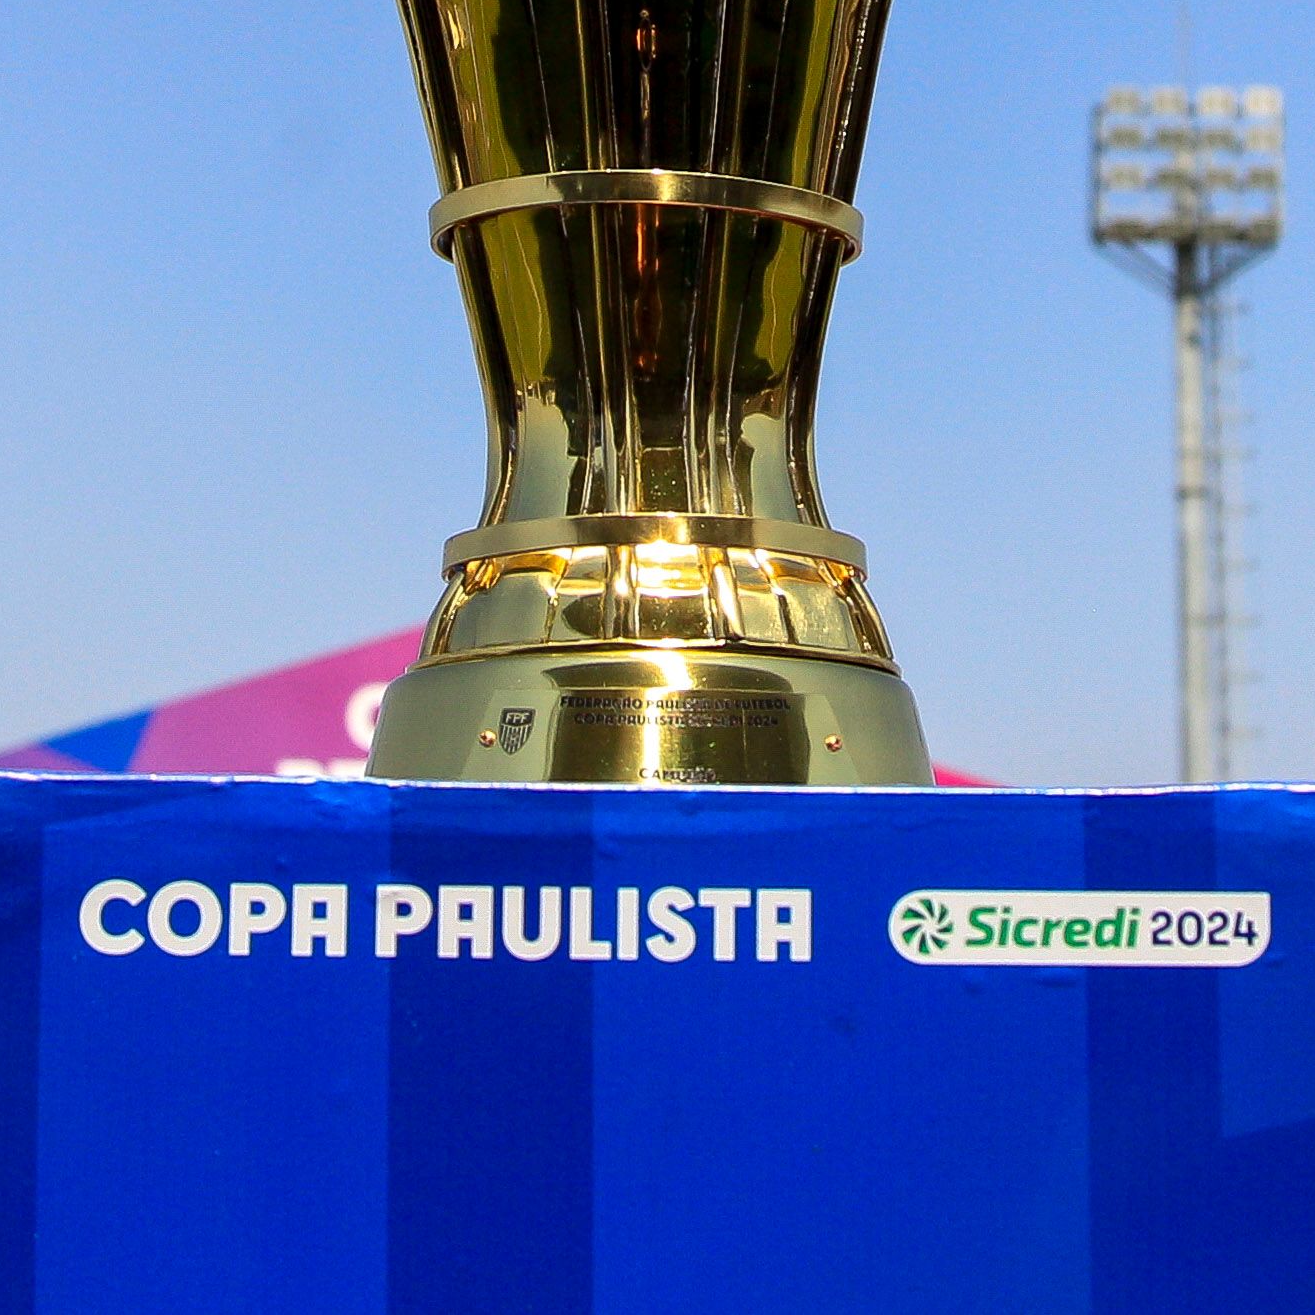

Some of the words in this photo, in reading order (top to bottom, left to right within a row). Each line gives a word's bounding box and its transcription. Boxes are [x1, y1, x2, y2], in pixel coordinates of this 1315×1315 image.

[506, 712, 531, 724] FPF
[79, 879, 347, 957] COPA
[375, 883, 812, 962] PAULISTA
[965, 906, 1142, 949] Sicredi
[1151, 910, 1259, 948] 2024
